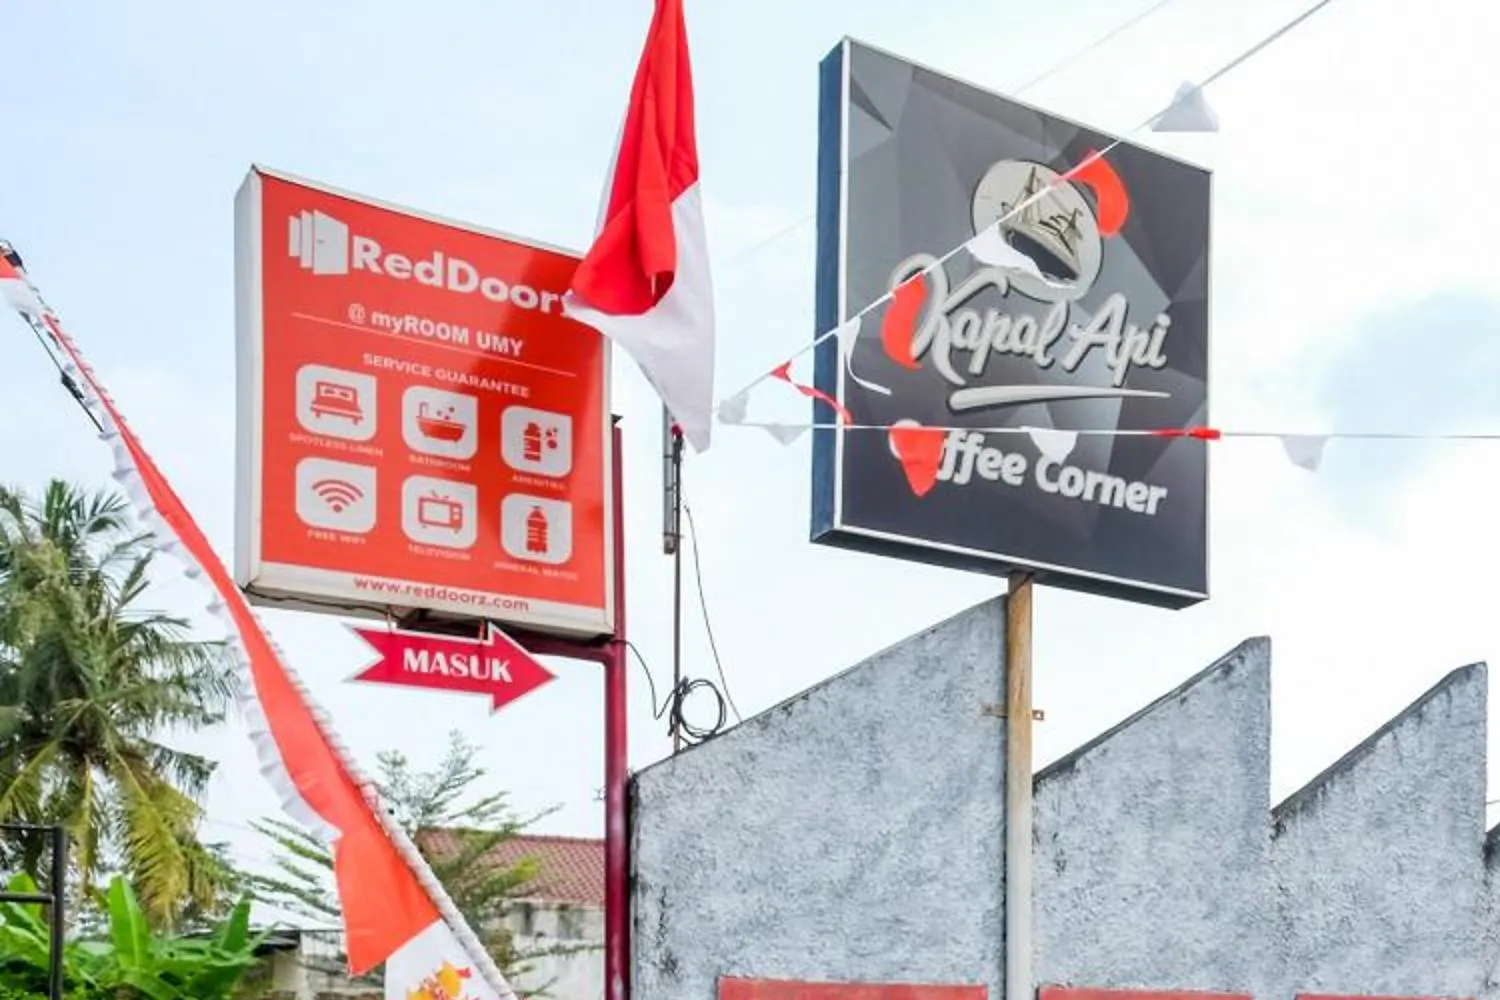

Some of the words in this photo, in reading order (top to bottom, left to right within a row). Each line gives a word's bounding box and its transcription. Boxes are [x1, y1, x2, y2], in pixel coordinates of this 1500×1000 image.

[348, 303, 366, 325] @
[371, 311, 469, 345] myROOM
[476, 330, 524, 358] UMY
[888, 252, 1069, 387] Kapal
[1063, 292, 1171, 387] Api
[363, 352, 432, 377] SERVICE
[435, 367, 530, 398] GUARANTEE
[889, 418, 1027, 486] ffee
[1035, 453, 1168, 515] Corner
[353, 576, 530, 612] www.reddoorz.com
[403, 648, 513, 683] MASUK
